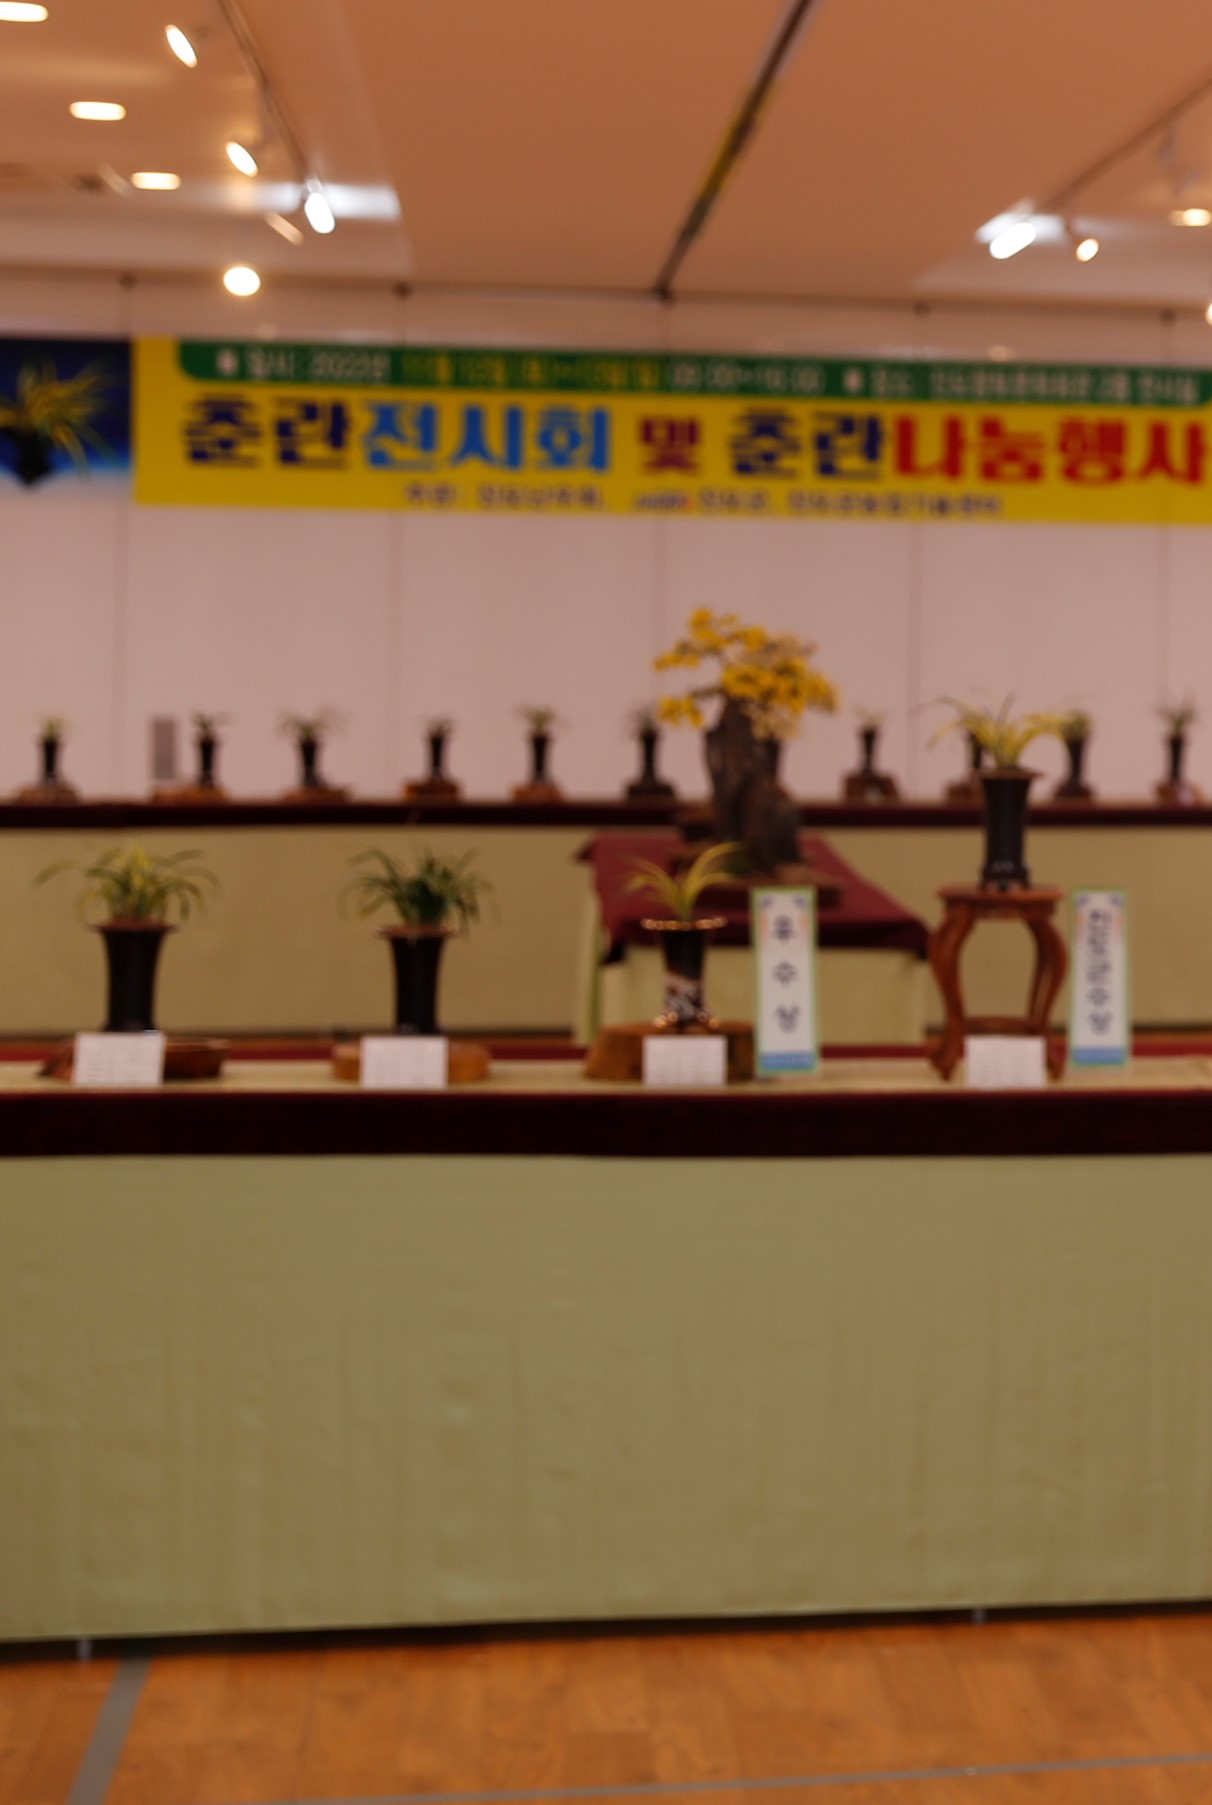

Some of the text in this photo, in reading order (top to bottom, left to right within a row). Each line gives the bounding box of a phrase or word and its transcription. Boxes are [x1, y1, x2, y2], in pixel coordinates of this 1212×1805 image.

[184, 393, 1210, 486] 춘란전시회 및 춘란나눔행사
